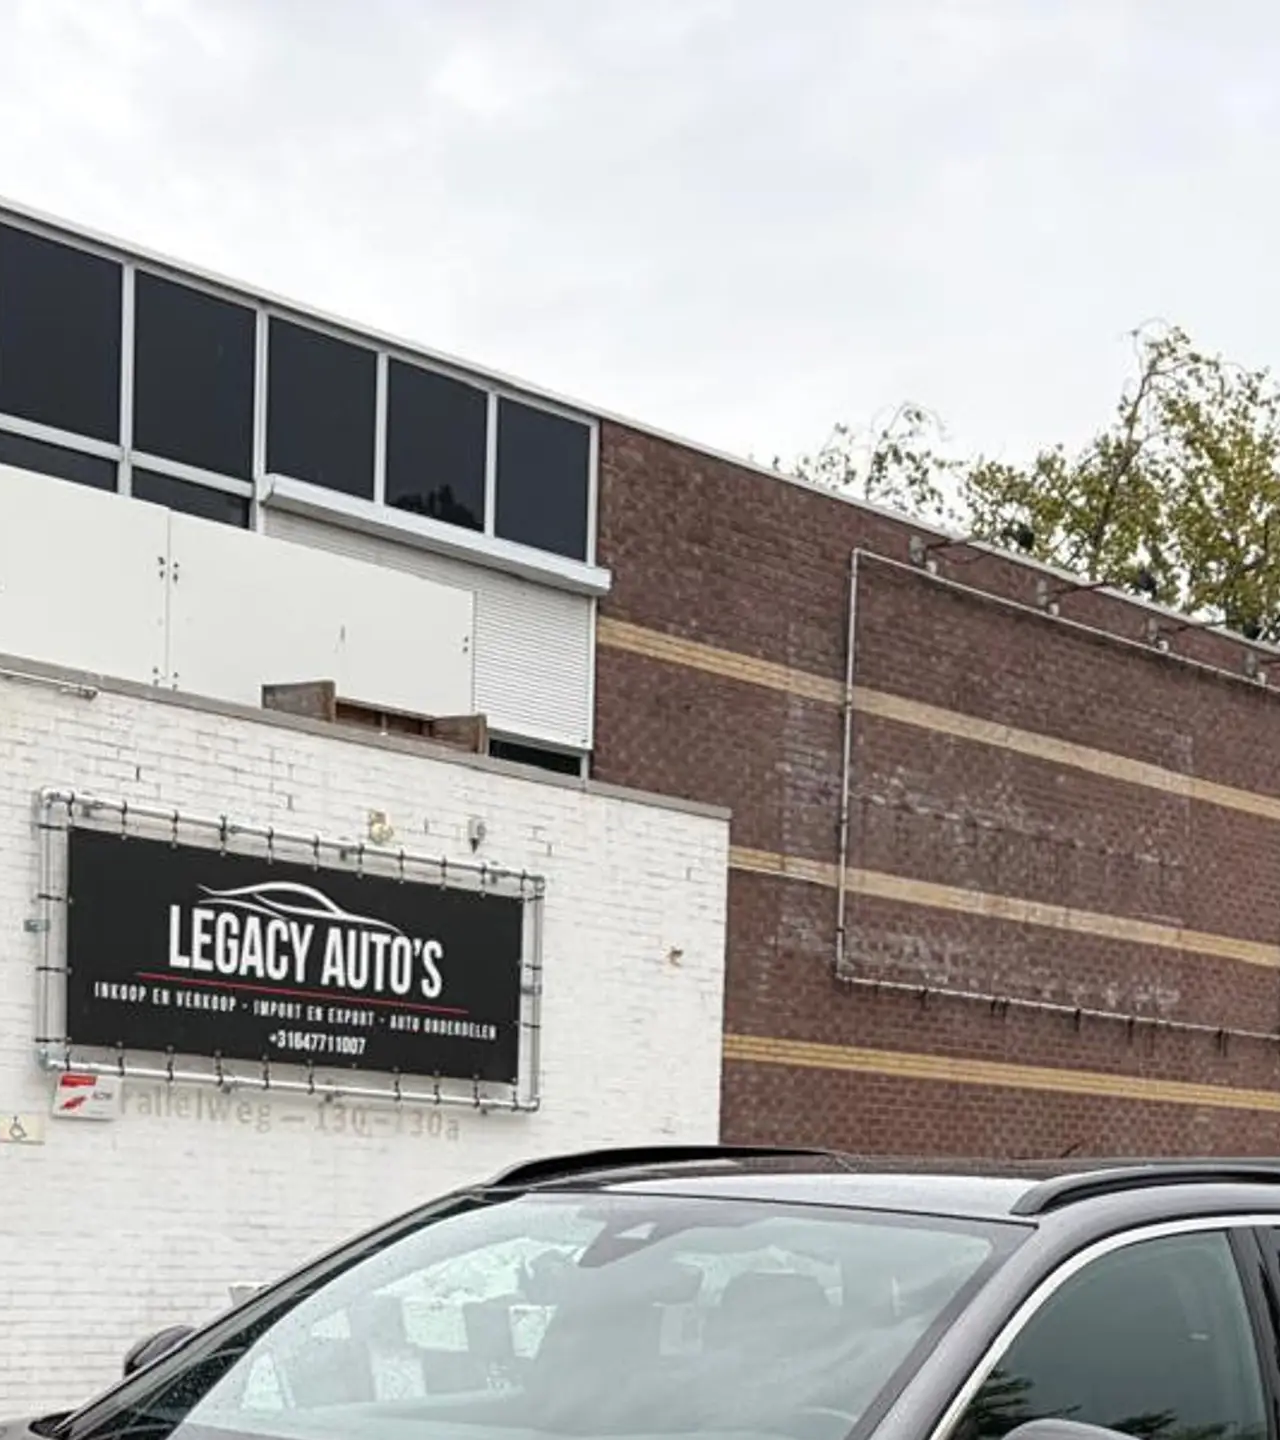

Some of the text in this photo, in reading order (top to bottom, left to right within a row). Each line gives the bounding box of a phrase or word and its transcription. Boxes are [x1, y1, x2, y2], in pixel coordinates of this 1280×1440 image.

[169, 904, 443, 999] LEGACY AUTO'S
[94, 981, 497, 1041] INKOOP EN VERKOOP IMPORT EN EXPORT AUTO ONDERDELEN
